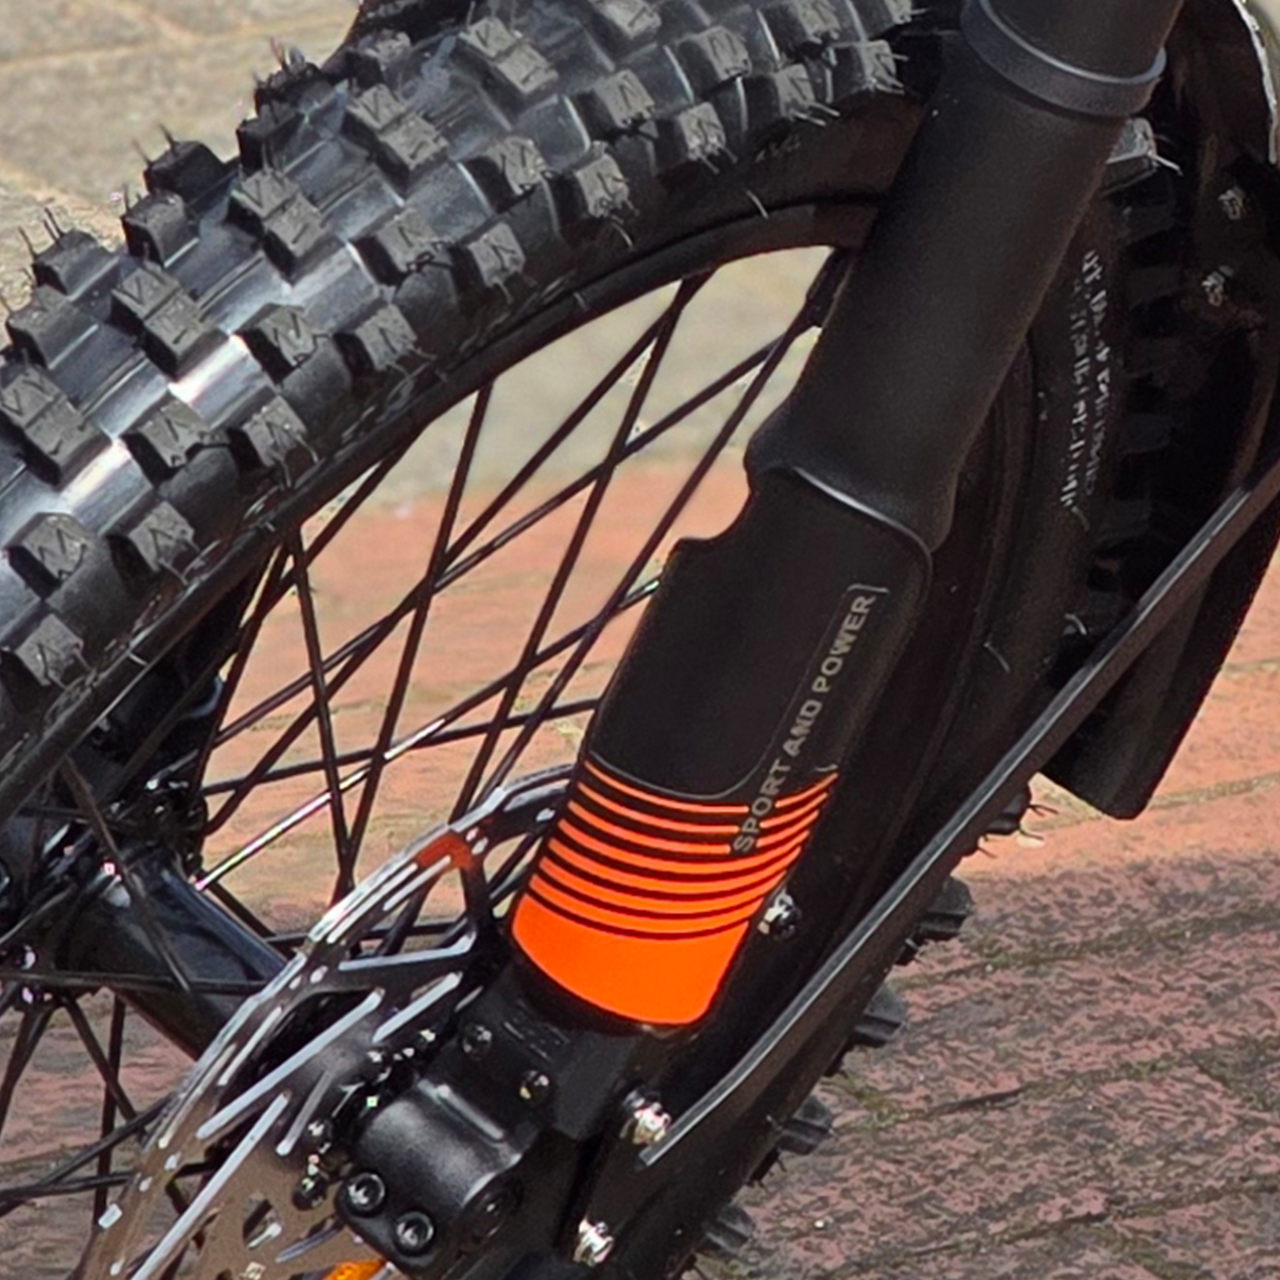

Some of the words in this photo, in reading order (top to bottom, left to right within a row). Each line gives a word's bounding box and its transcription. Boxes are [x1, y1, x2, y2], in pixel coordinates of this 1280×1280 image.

[733, 757, 791, 852] SPORT
[783, 699, 822, 757] AND
[811, 595, 876, 693] POWER
